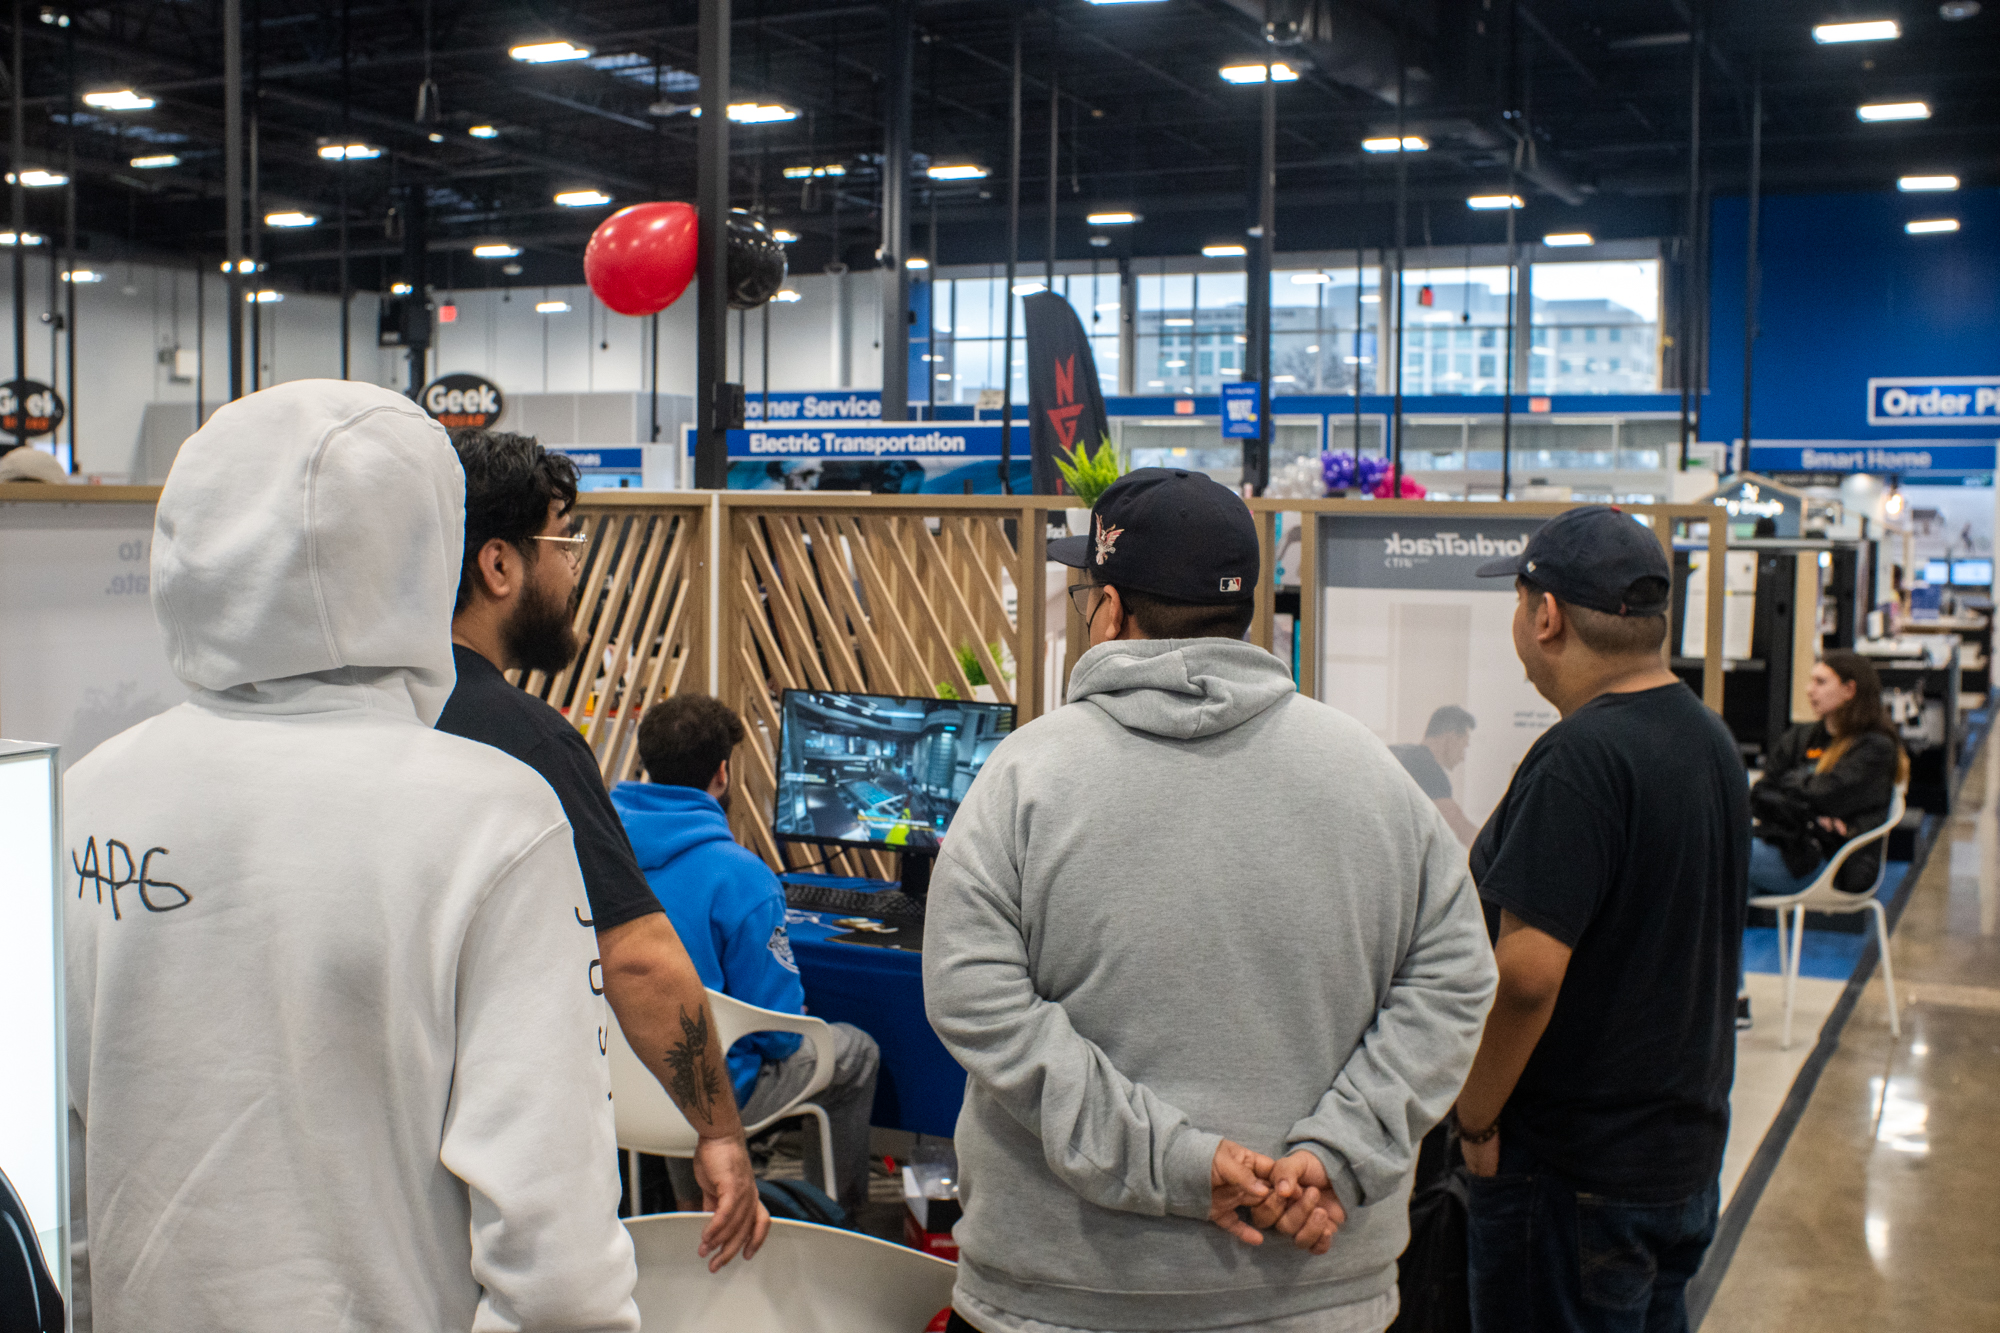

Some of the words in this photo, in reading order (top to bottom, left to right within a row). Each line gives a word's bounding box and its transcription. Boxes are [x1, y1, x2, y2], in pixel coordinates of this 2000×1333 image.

[426, 384, 499, 414] Geek
[803, 395, 882, 418] Service
[1882, 387, 1972, 416] Order
[750, 432, 820, 453] Electric
[821, 431, 966, 456] Transportation
[1867, 448, 1932, 469] Home
